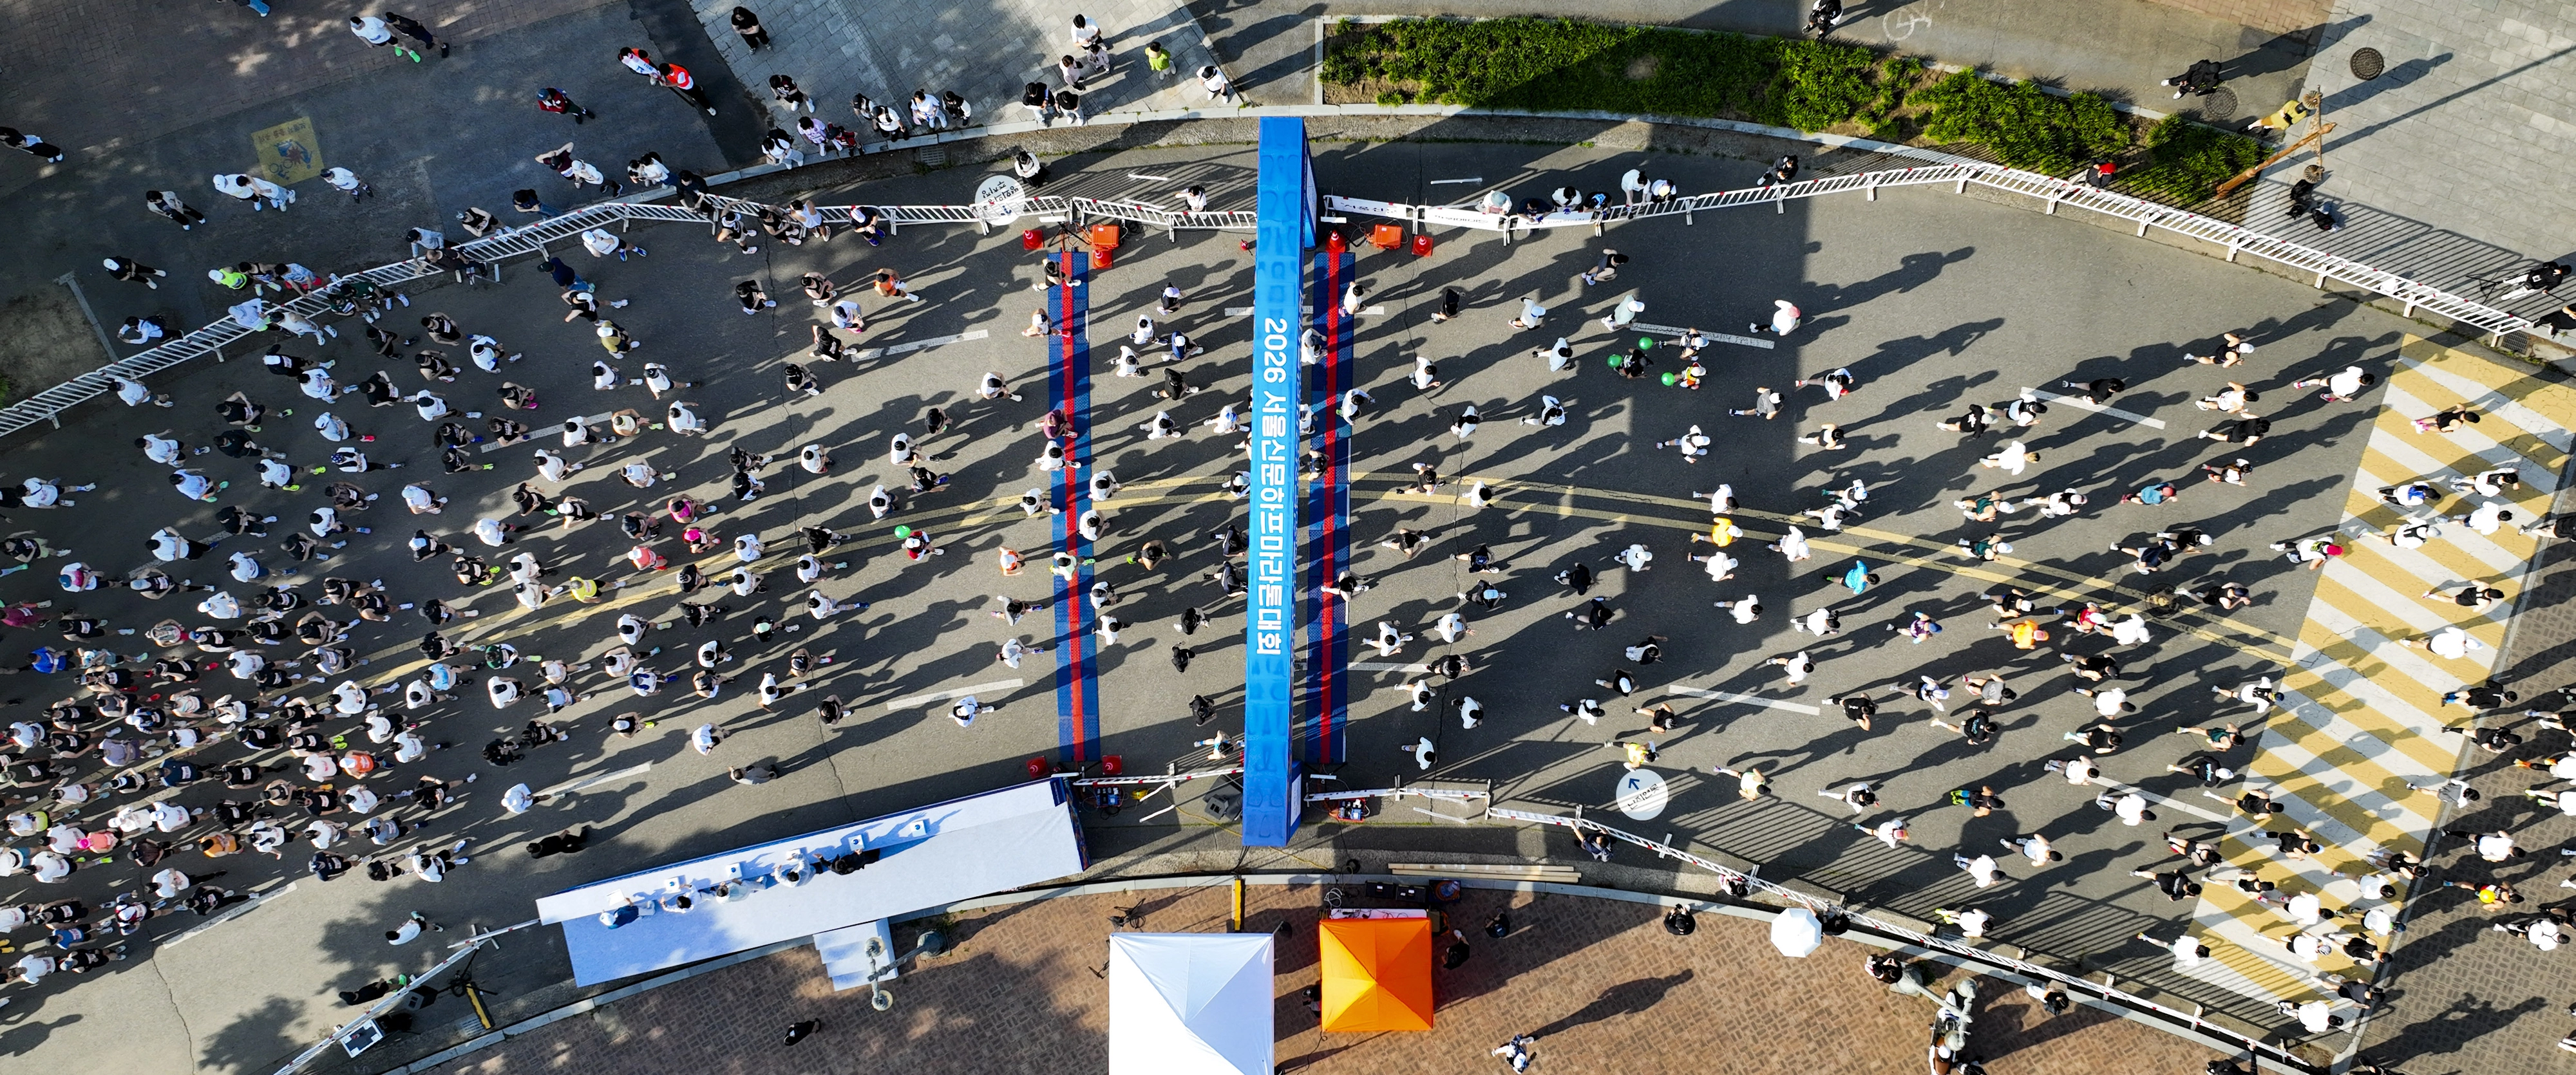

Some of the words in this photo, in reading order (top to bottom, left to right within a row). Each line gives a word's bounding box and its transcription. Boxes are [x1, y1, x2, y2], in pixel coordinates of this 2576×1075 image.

[981, 181, 1006, 198] 주차장
[1264, 317, 1287, 383] 2026
[1256, 391, 1287, 655] 서울신문하프마라톤대회
[1627, 783, 1659, 810] 난지연못
